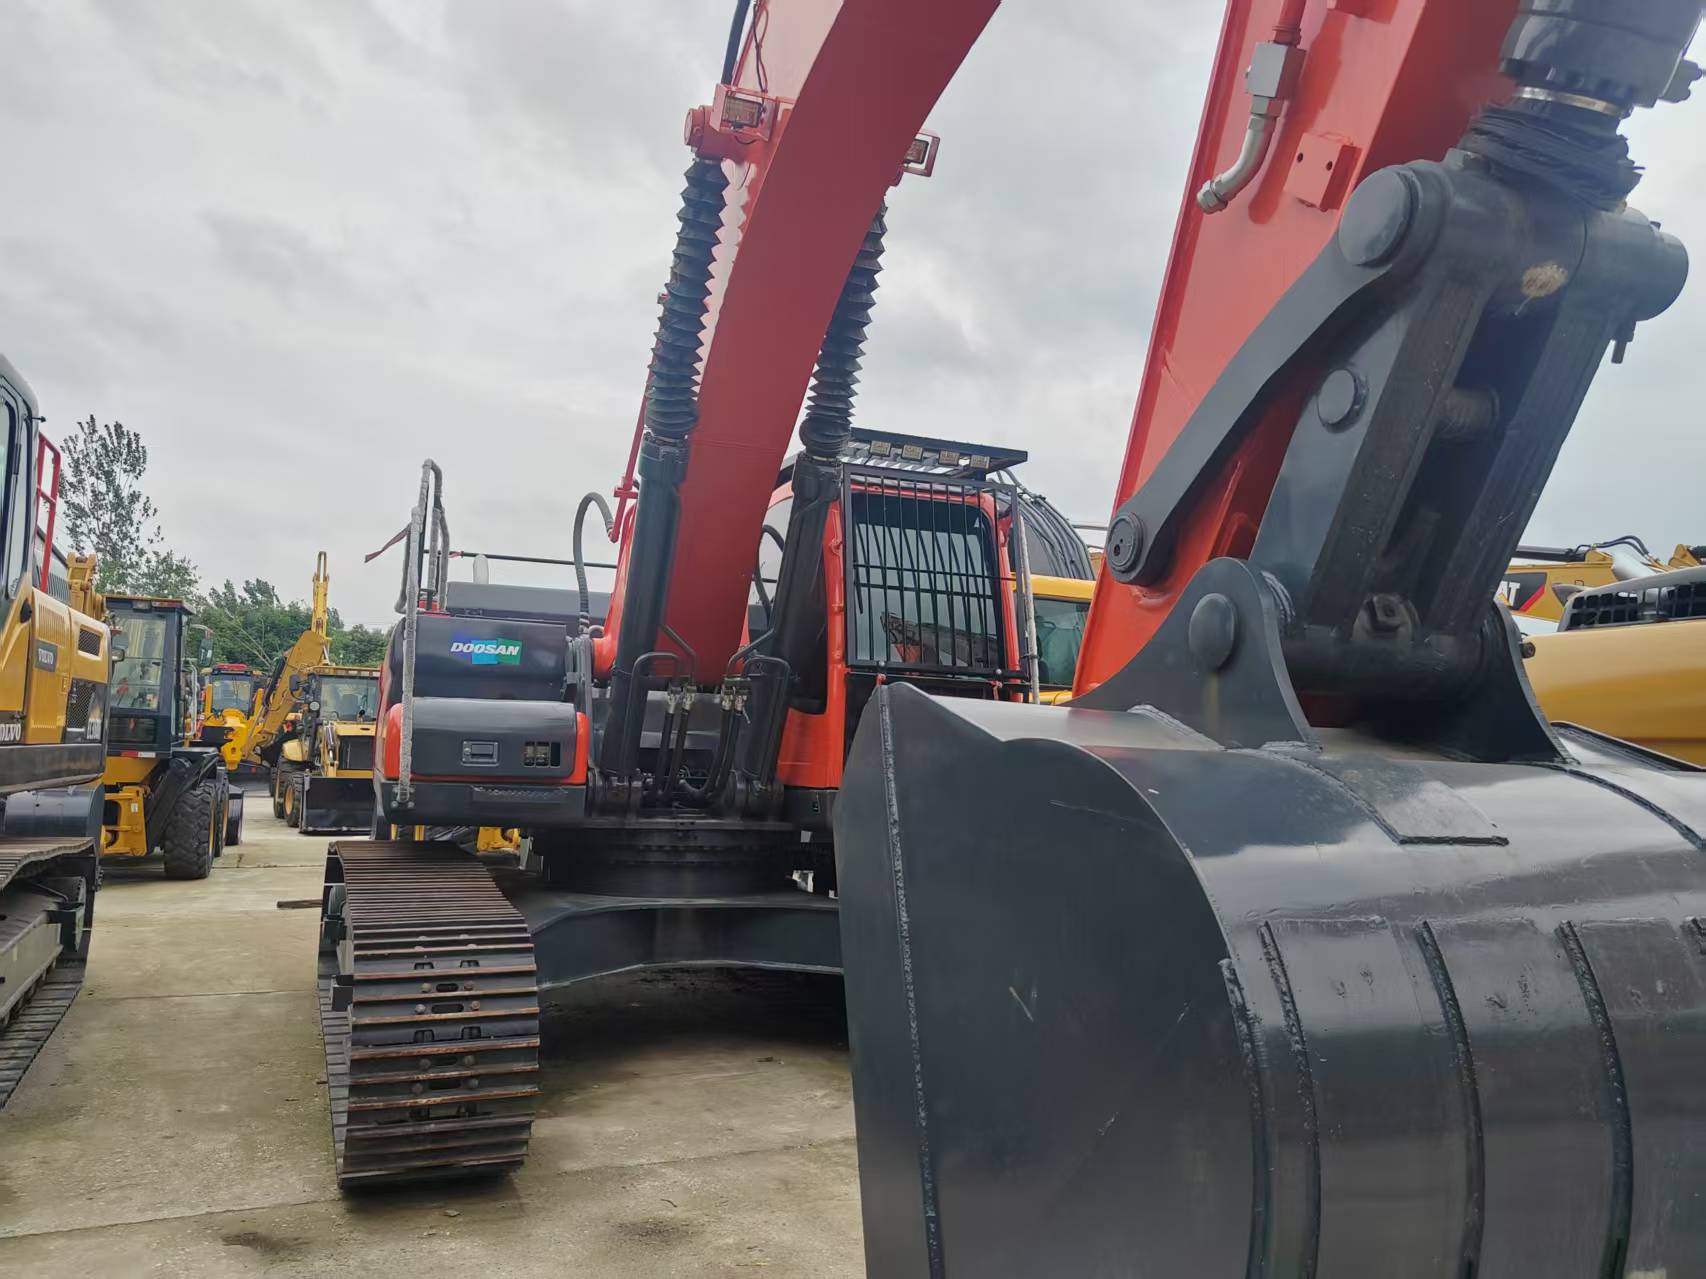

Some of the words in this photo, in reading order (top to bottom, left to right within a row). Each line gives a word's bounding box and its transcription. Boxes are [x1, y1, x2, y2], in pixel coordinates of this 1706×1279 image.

[1493, 580, 1520, 607] AT
[38, 647, 54, 665] VOLVO
[450, 642, 520, 655] DOOSAN
[0, 723, 22, 741] OLVO
